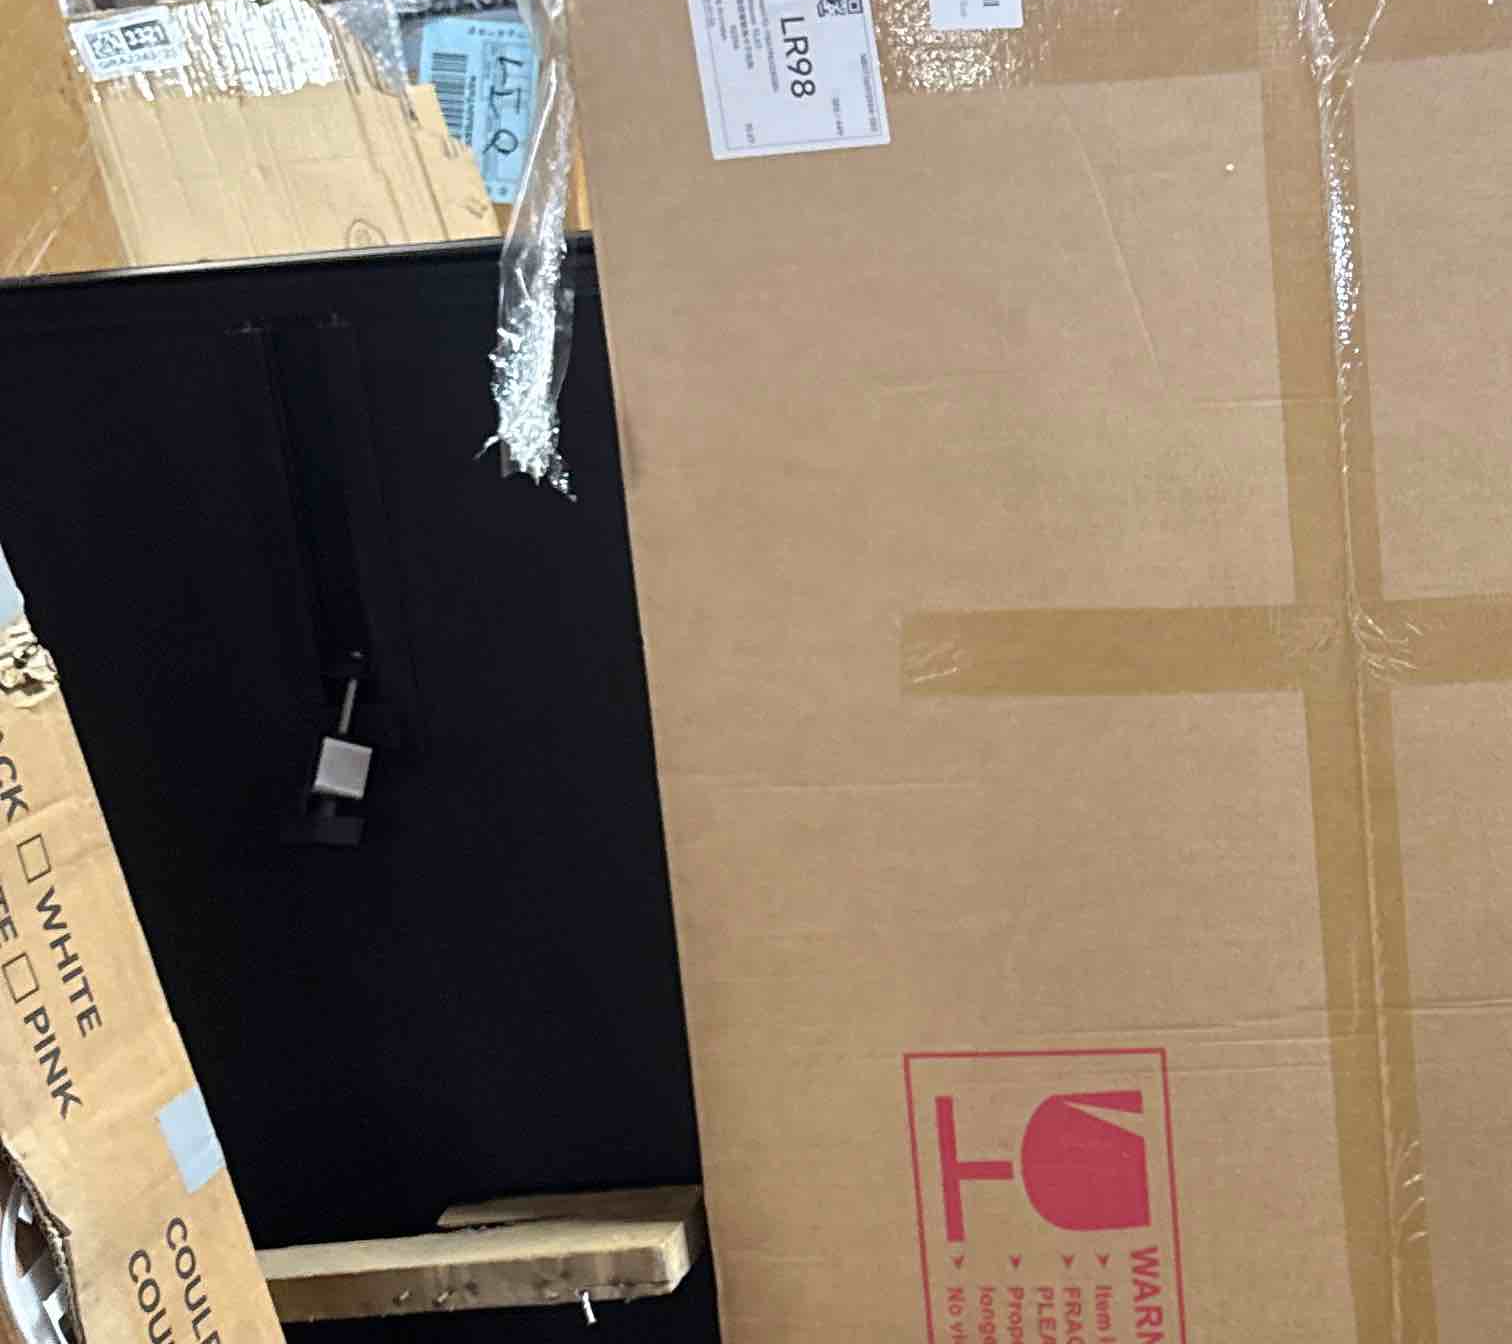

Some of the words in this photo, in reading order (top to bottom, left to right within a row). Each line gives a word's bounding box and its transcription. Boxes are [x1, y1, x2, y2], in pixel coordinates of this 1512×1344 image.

[780, 16, 816, 99] LR98
[35, 885, 103, 1039] WHITE
[23, 1005, 82, 1121] PINK
[948, 1287, 964, 1316] No
[1095, 1285, 1112, 1331] Item
